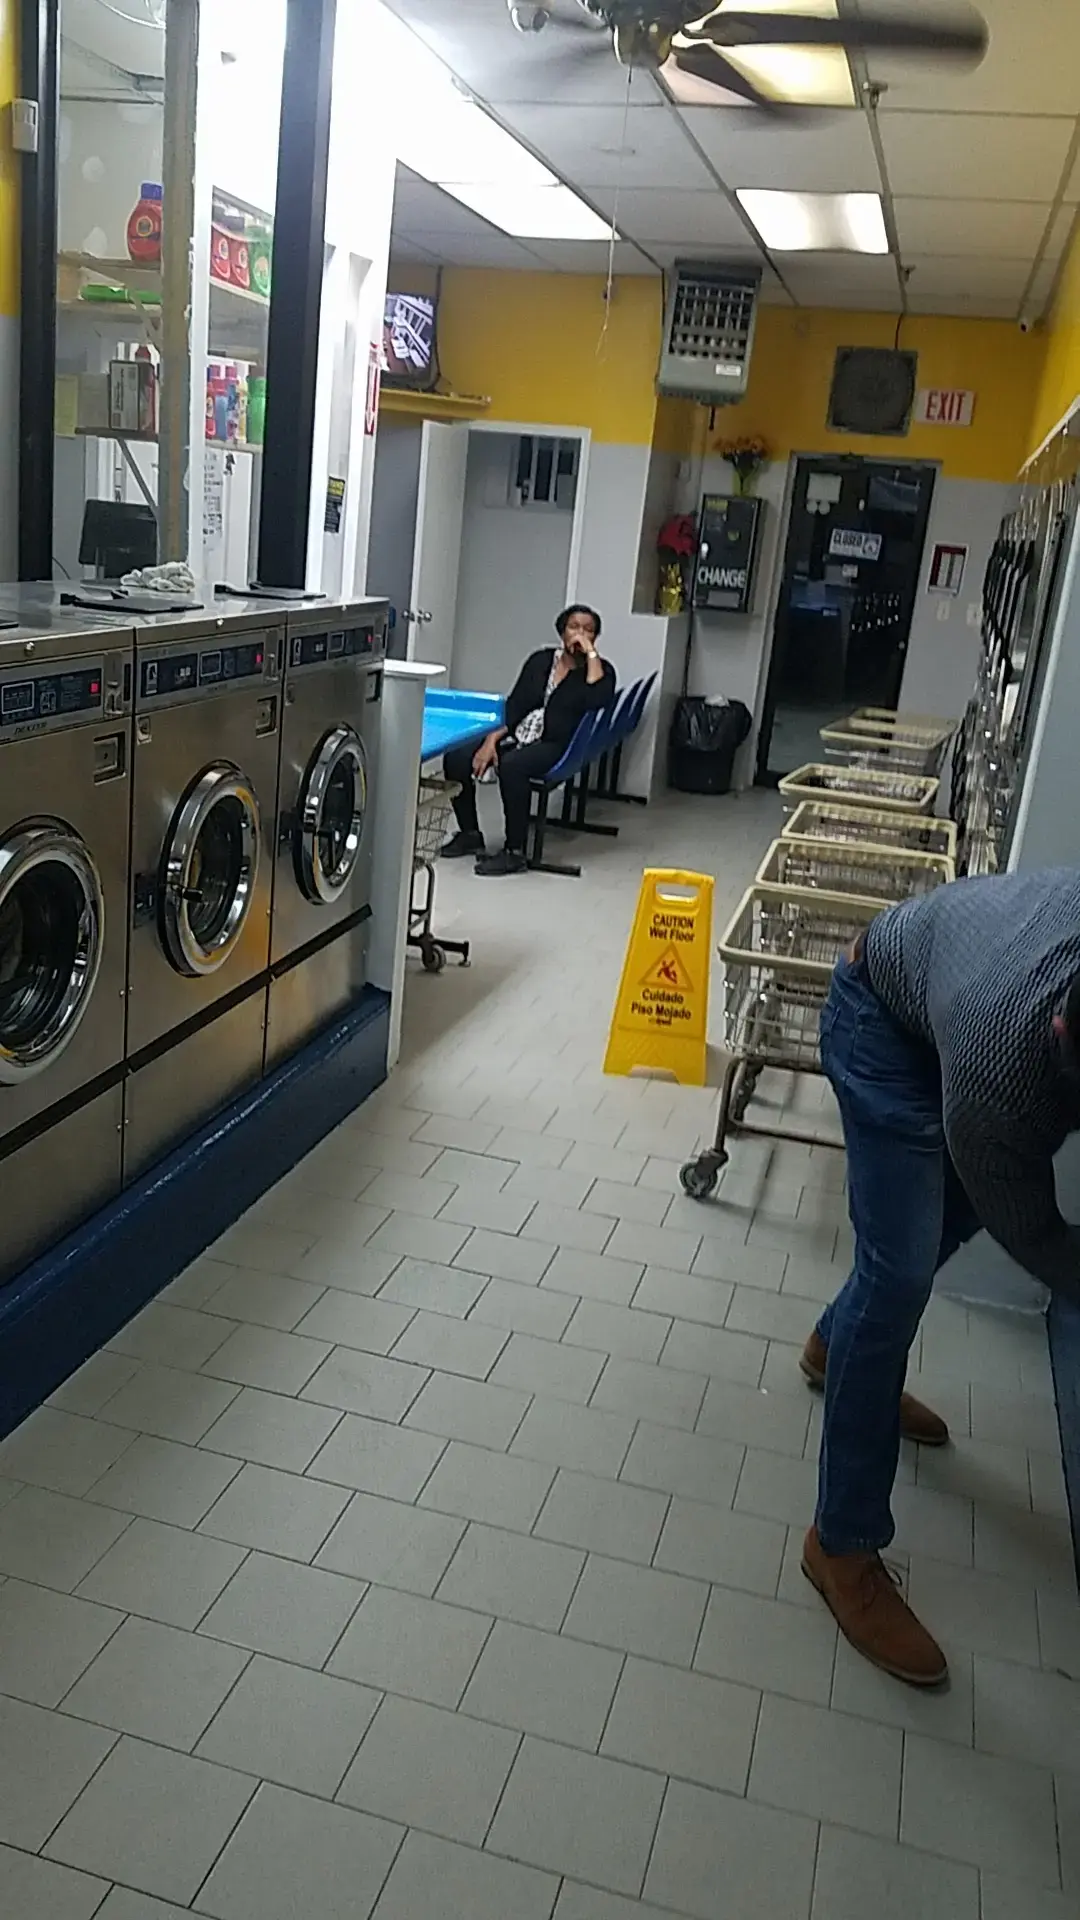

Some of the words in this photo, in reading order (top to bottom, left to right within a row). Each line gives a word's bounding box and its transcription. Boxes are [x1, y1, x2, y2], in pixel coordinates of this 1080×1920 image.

[926, 390, 966, 421] EXIT
[698, 566, 747, 588] CHANGE
[653, 913, 695, 929] CAUTION
[649, 926, 668, 940] Wet
[670, 928, 695, 942] Floor
[642, 988, 684, 1004] Cuidado
[631, 1001, 653, 1016] Piso
[655, 1004, 692, 1020] Mojado
